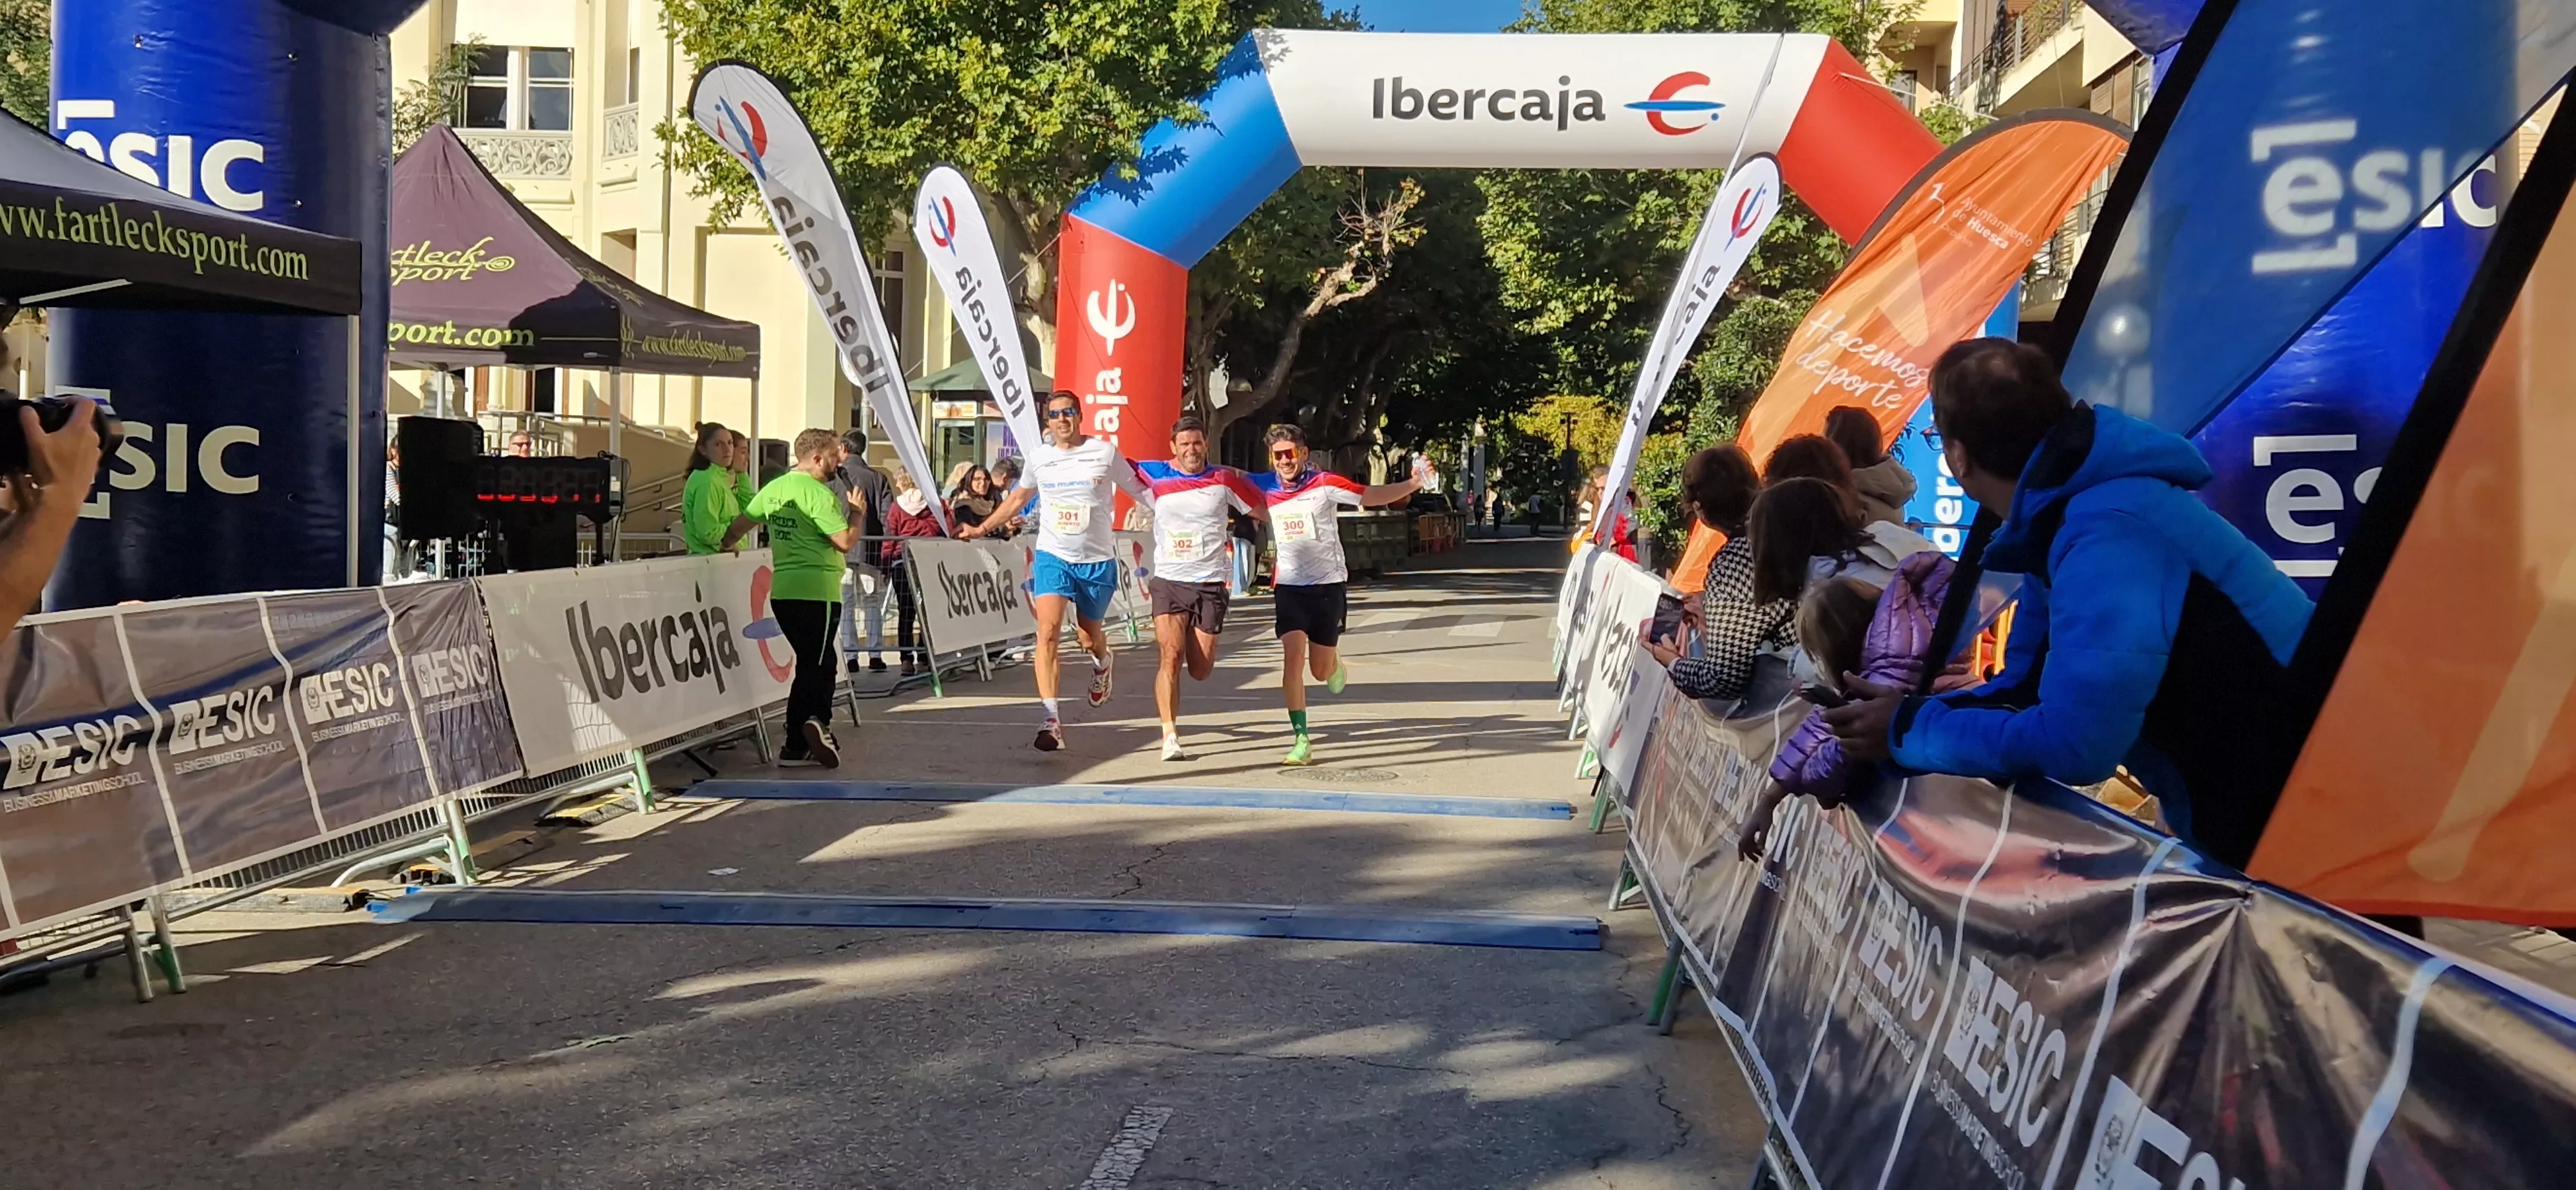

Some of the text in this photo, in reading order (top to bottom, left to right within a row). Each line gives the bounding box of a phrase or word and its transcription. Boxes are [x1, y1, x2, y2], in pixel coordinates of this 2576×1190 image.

[1372, 75, 1606, 132] Ibercaja
[1952, 207, 2010, 250] de Huesca
[1961, 196, 2033, 247] Ayuntamiento
[1795, 343, 1904, 410] deporte
[1806, 309, 1931, 388] Hacemos
[1057, 511, 1079, 521] 301
[1282, 520, 1305, 531] 300
[936, 553, 1018, 624] Ibercaja
[431, 643, 489, 694] ESIC
[565, 581, 741, 705] Ibercaja
[199, 685, 276, 748] ESIC
[323, 662, 394, 719] ESIC
[35, 715, 142, 782] ESIC
[1873, 889, 1944, 1021] ESIC
[1964, 975, 2067, 1148] ESIC
